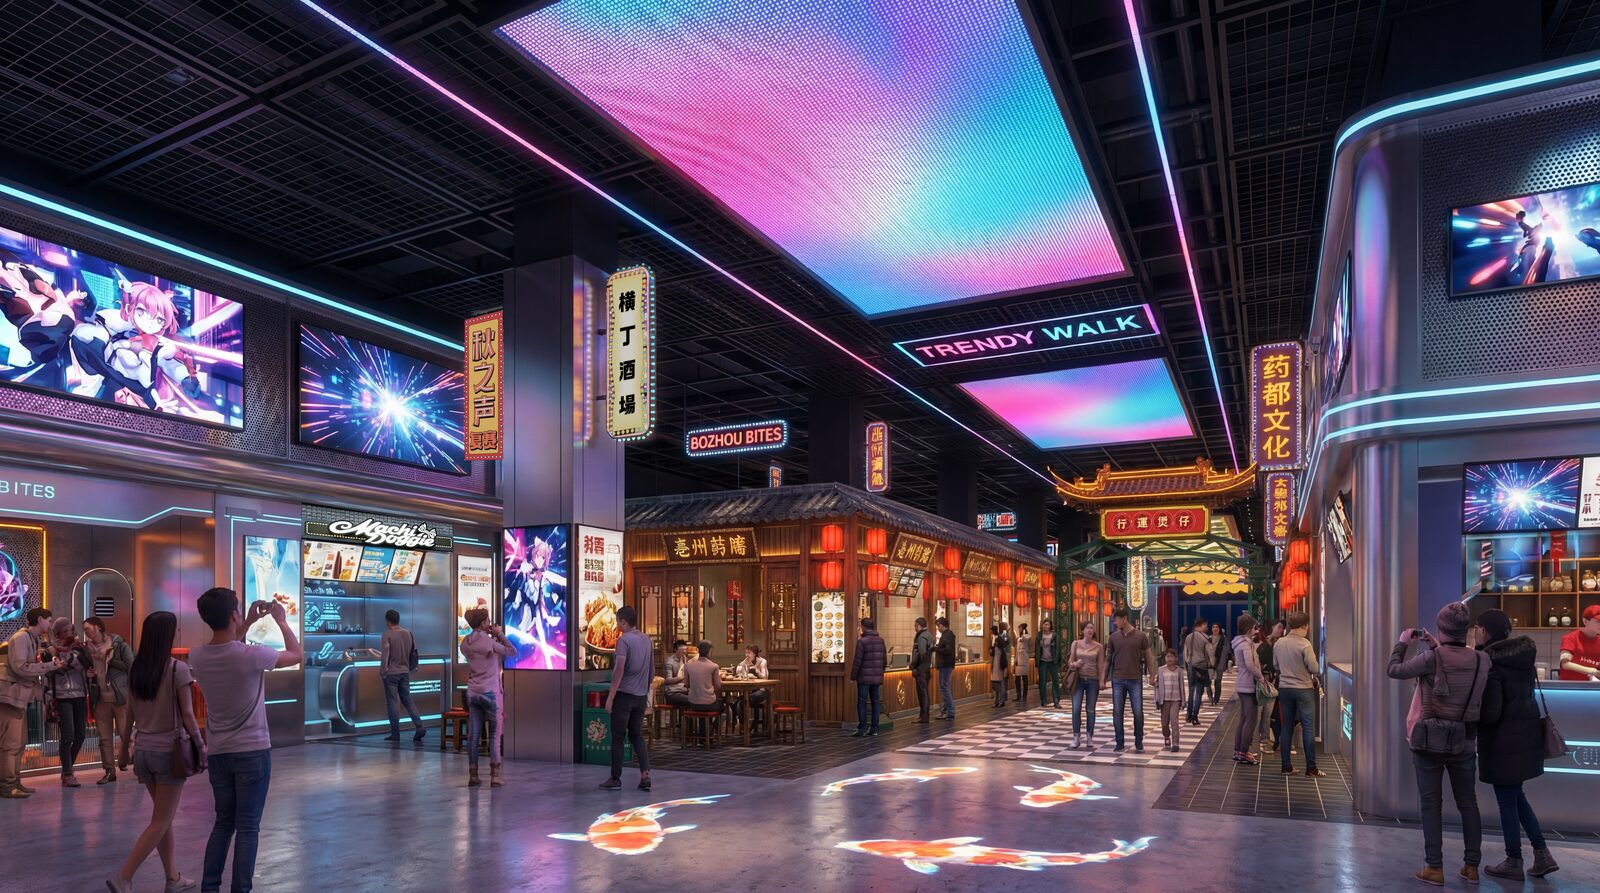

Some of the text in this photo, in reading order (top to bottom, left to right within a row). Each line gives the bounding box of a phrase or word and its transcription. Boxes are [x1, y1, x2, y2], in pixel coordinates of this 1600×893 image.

[914, 314, 1143, 359] TRENDY WALK
[618, 290, 636, 416] 横丁酒場
[471, 327, 497, 427] 秋之声
[1262, 353, 1291, 460] 药都文化
[690, 426, 783, 451] BOZHOU BITES
[0, 480, 56, 499] BITES
[328, 518, 418, 536] Machi
[1116, 514, 1190, 530] 行運煲仔
[365, 531, 436, 548] Doggie
